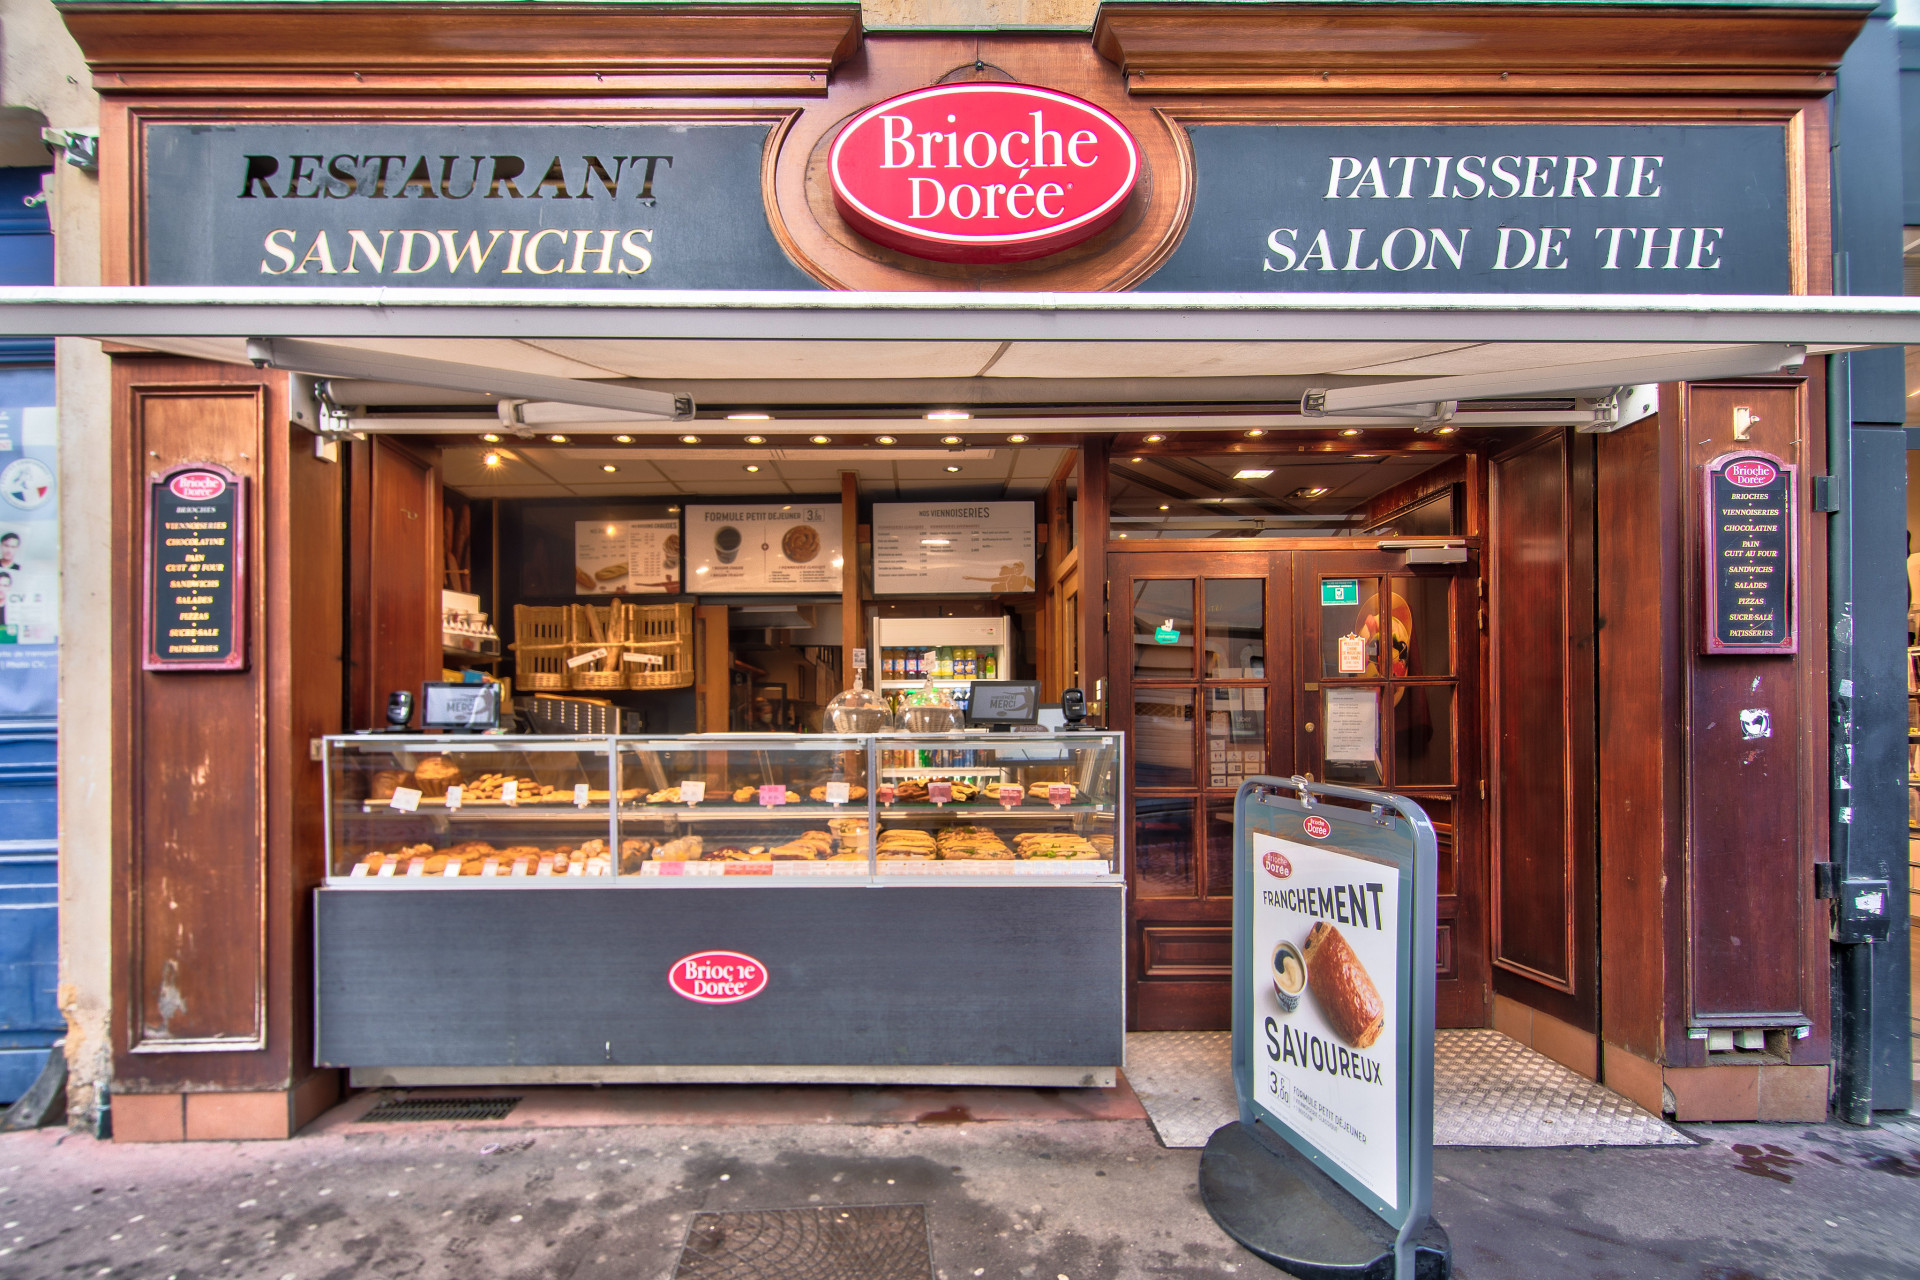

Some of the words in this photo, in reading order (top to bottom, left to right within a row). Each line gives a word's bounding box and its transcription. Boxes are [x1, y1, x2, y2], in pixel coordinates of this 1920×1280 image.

[878, 110, 1099, 169] Brioche
[236, 154, 674, 200] RESTAURANT
[1323, 154, 1665, 200] PATISSERIE
[907, 168, 1065, 220] Dorée
[260, 228, 655, 276] SANDWICHS
[1262, 227, 1468, 273] SALON
[1491, 226, 1572, 271] DE
[1594, 227, 1724, 271] THE
[1732, 465, 1770, 477] Brioche
[177, 477, 219, 489] Brioche
[704, 511, 744, 522] FORMULE
[746, 512, 767, 521] PETIT
[930, 506, 990, 518] VIENNOISERIES
[165, 522, 227, 530] VIENNOISERIES
[165, 538, 225, 546] CHOCOLATINE
[185, 554, 206, 562] PAIN
[165, 564, 187, 572] CUIT
[188, 564, 202, 572] AU
[202, 564, 225, 572] FOUR
[169, 580, 220, 588] SANDWICHS
[176, 596, 213, 604] SALADES
[179, 612, 210, 621] PIZZAS
[168, 644, 219, 653] PATISSERIES
[446, 702, 475, 712] MERC
[989, 699, 1016, 709] MERCI
[1307, 822, 1327, 835] Dorée
[1267, 853, 1288, 865] Brioche
[1265, 860, 1290, 876] Dorée
[1263, 882, 1384, 931] FRANCHEMENT
[693, 979, 745, 996] Dorée
[1264, 1016, 1383, 1086] SAVOUREUX
[1293, 1086, 1318, 1110] FORMULE
[1318, 1103, 1334, 1121] PETIT
[1335, 1114, 1367, 1144] DÉJEUNER
